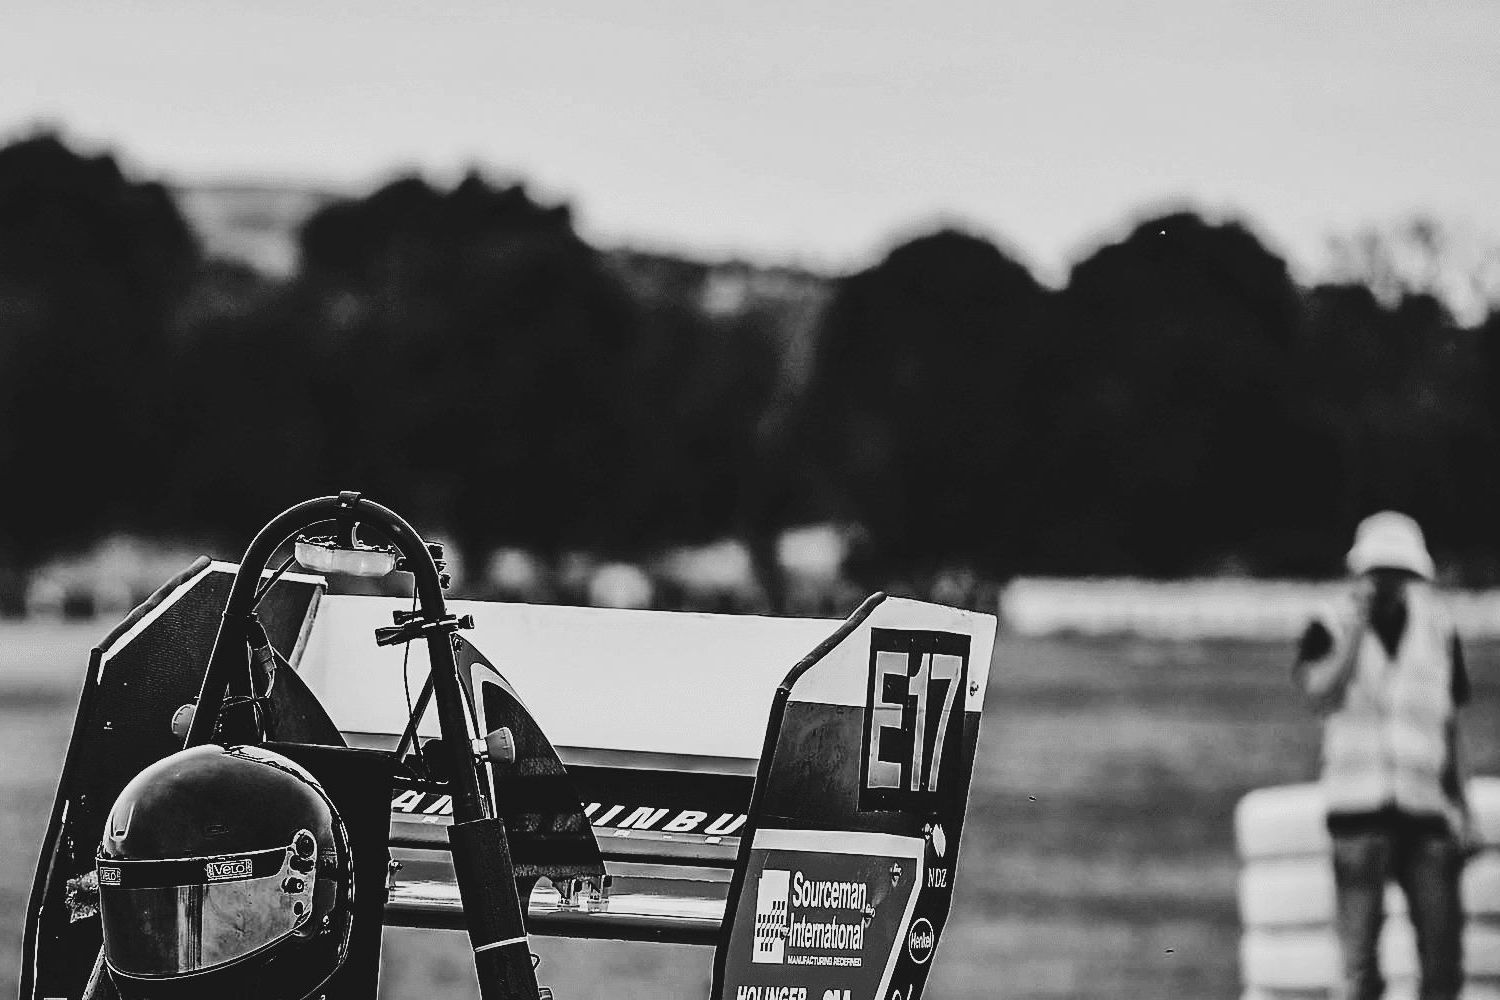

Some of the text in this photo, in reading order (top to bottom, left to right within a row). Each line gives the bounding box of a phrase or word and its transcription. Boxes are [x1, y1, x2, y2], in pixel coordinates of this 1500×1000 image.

[867, 650, 963, 792] E17
[792, 871, 867, 910] Sourceman
[928, 868, 947, 887] NDZ
[788, 912, 866, 950] International
[911, 931, 932, 948] Henkel
[787, 955, 862, 967] MANUFACTURING REDEFINED
